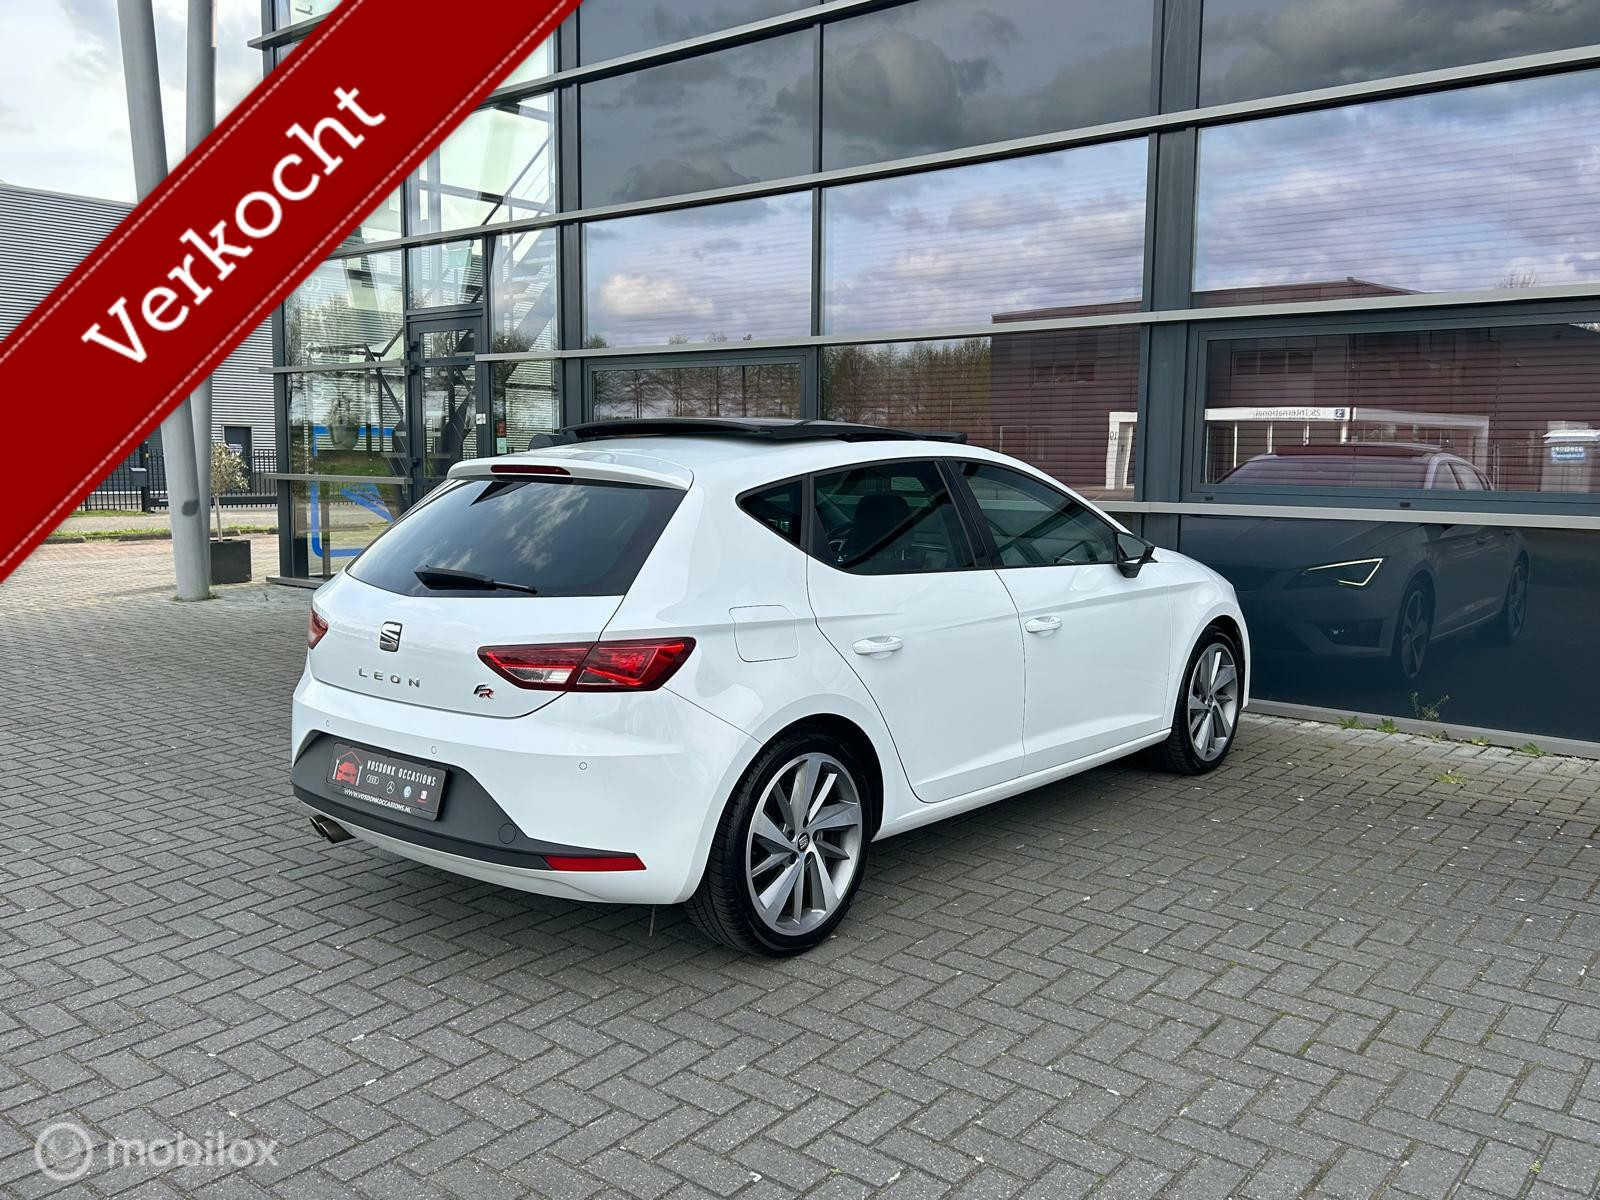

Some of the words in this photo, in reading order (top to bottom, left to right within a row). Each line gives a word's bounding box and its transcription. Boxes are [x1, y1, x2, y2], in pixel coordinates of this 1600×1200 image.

[359, 668, 420, 687] LEON
[473, 683, 495, 700] FR
[366, 759, 396, 776] VOSDONK
[398, 767, 437, 787] OCCASIONS
